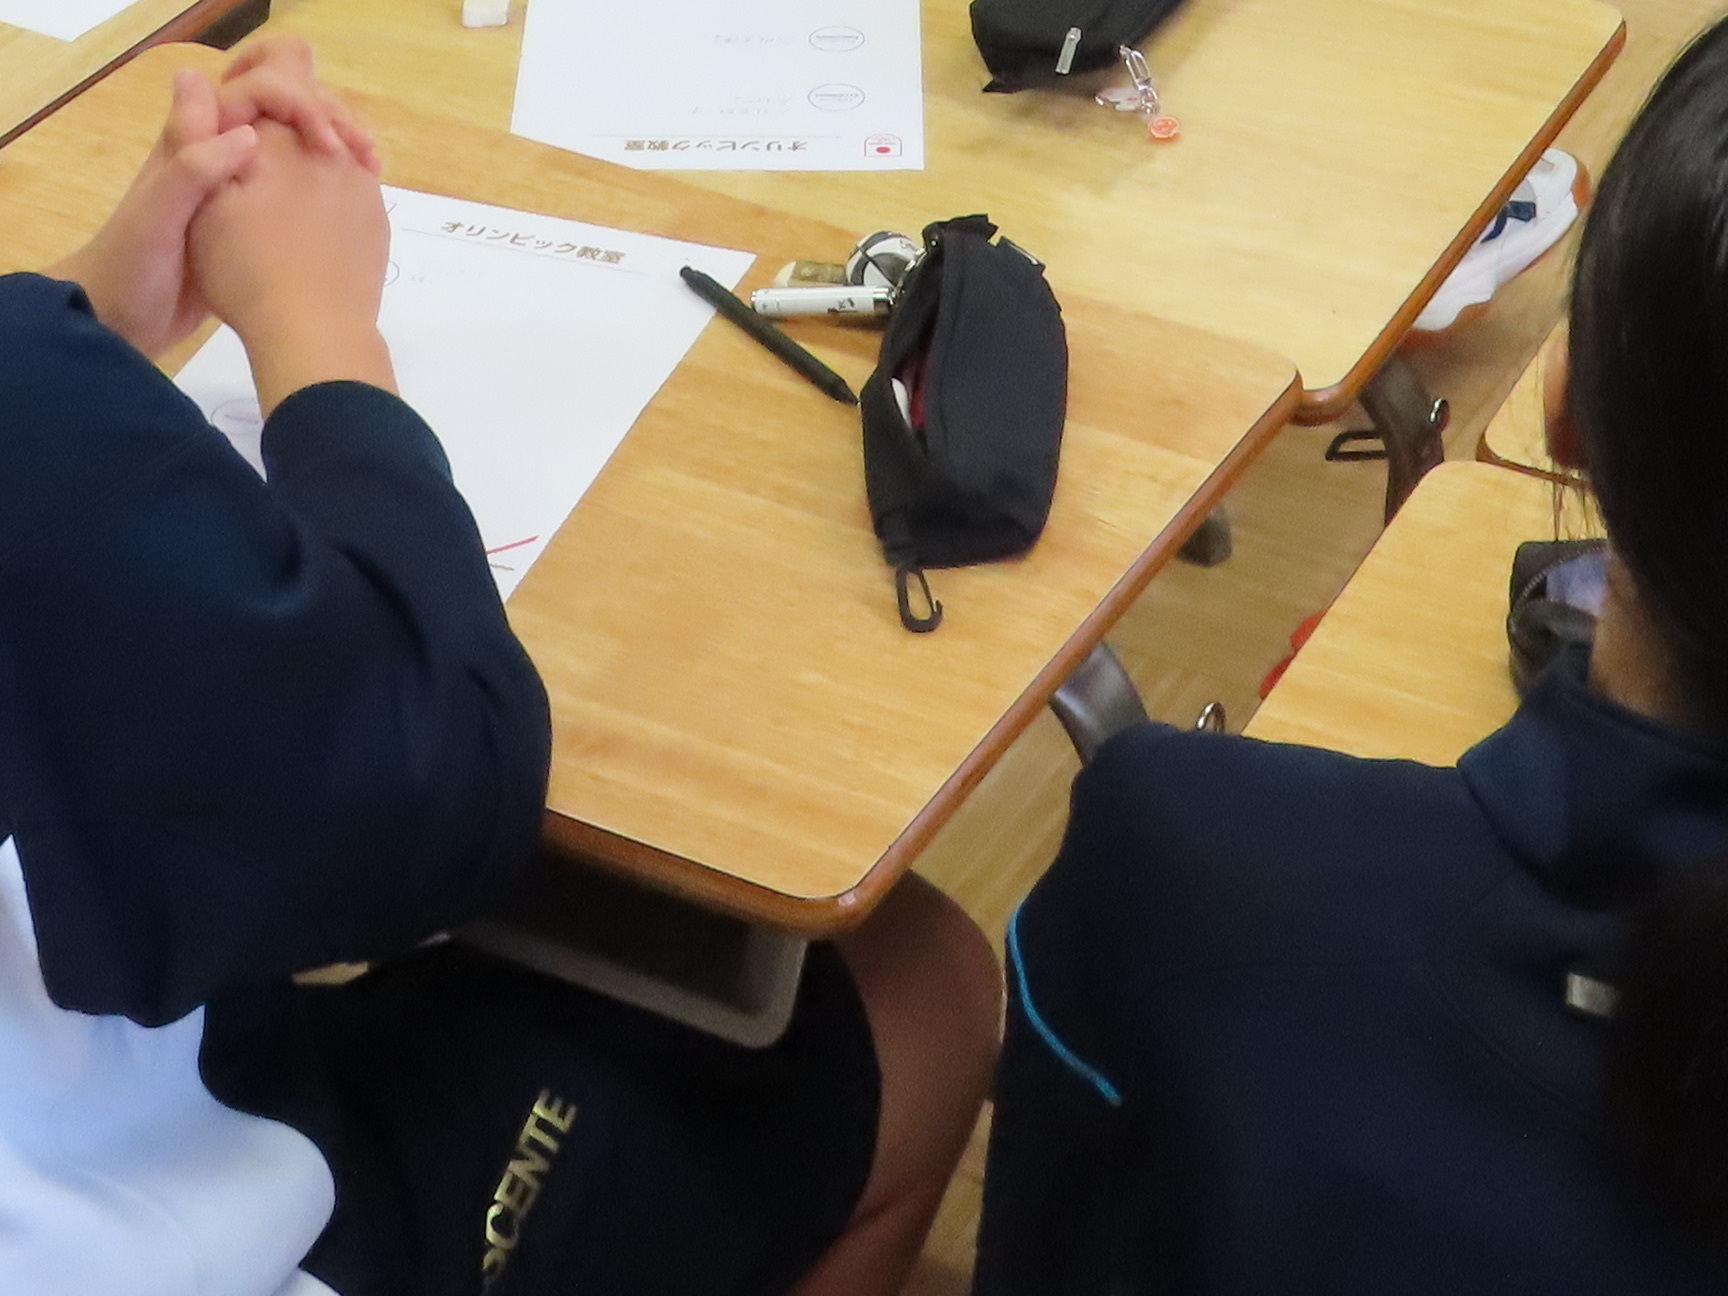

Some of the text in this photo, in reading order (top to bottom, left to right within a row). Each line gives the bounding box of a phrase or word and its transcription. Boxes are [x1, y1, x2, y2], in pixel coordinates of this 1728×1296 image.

[623, 139, 809, 153] オリンピック教室
[440, 220, 626, 265] オリンピック教室
